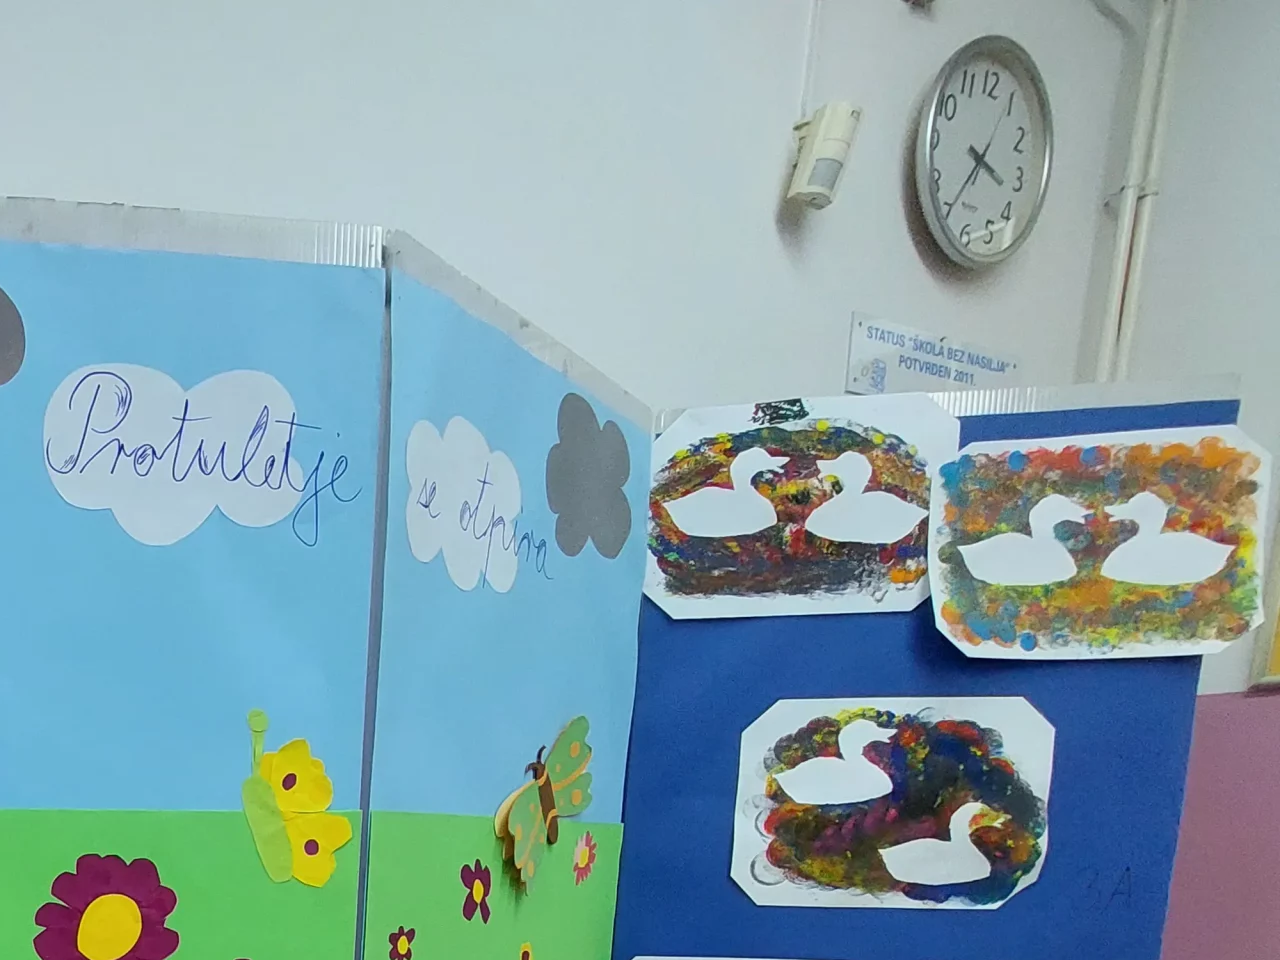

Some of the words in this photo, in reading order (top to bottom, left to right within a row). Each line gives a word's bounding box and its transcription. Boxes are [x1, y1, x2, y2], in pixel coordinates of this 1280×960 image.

[960, 69, 976, 98] 11
[981, 69, 1000, 101] 12
[938, 91, 957, 121] 10
[1006, 91, 1015, 117] 1
[1013, 126, 1026, 155] 2
[1012, 166, 1024, 192] 3
[943, 201, 953, 220] 7
[1000, 200, 1012, 222] 4
[959, 223, 972, 248] 6
[983, 219, 995, 245] 5
[866, 325, 906, 349] STATUS
[947, 347, 966, 363] BEZ
[898, 354, 951, 380] POTVRDEN
[416, 478, 441, 519] se
